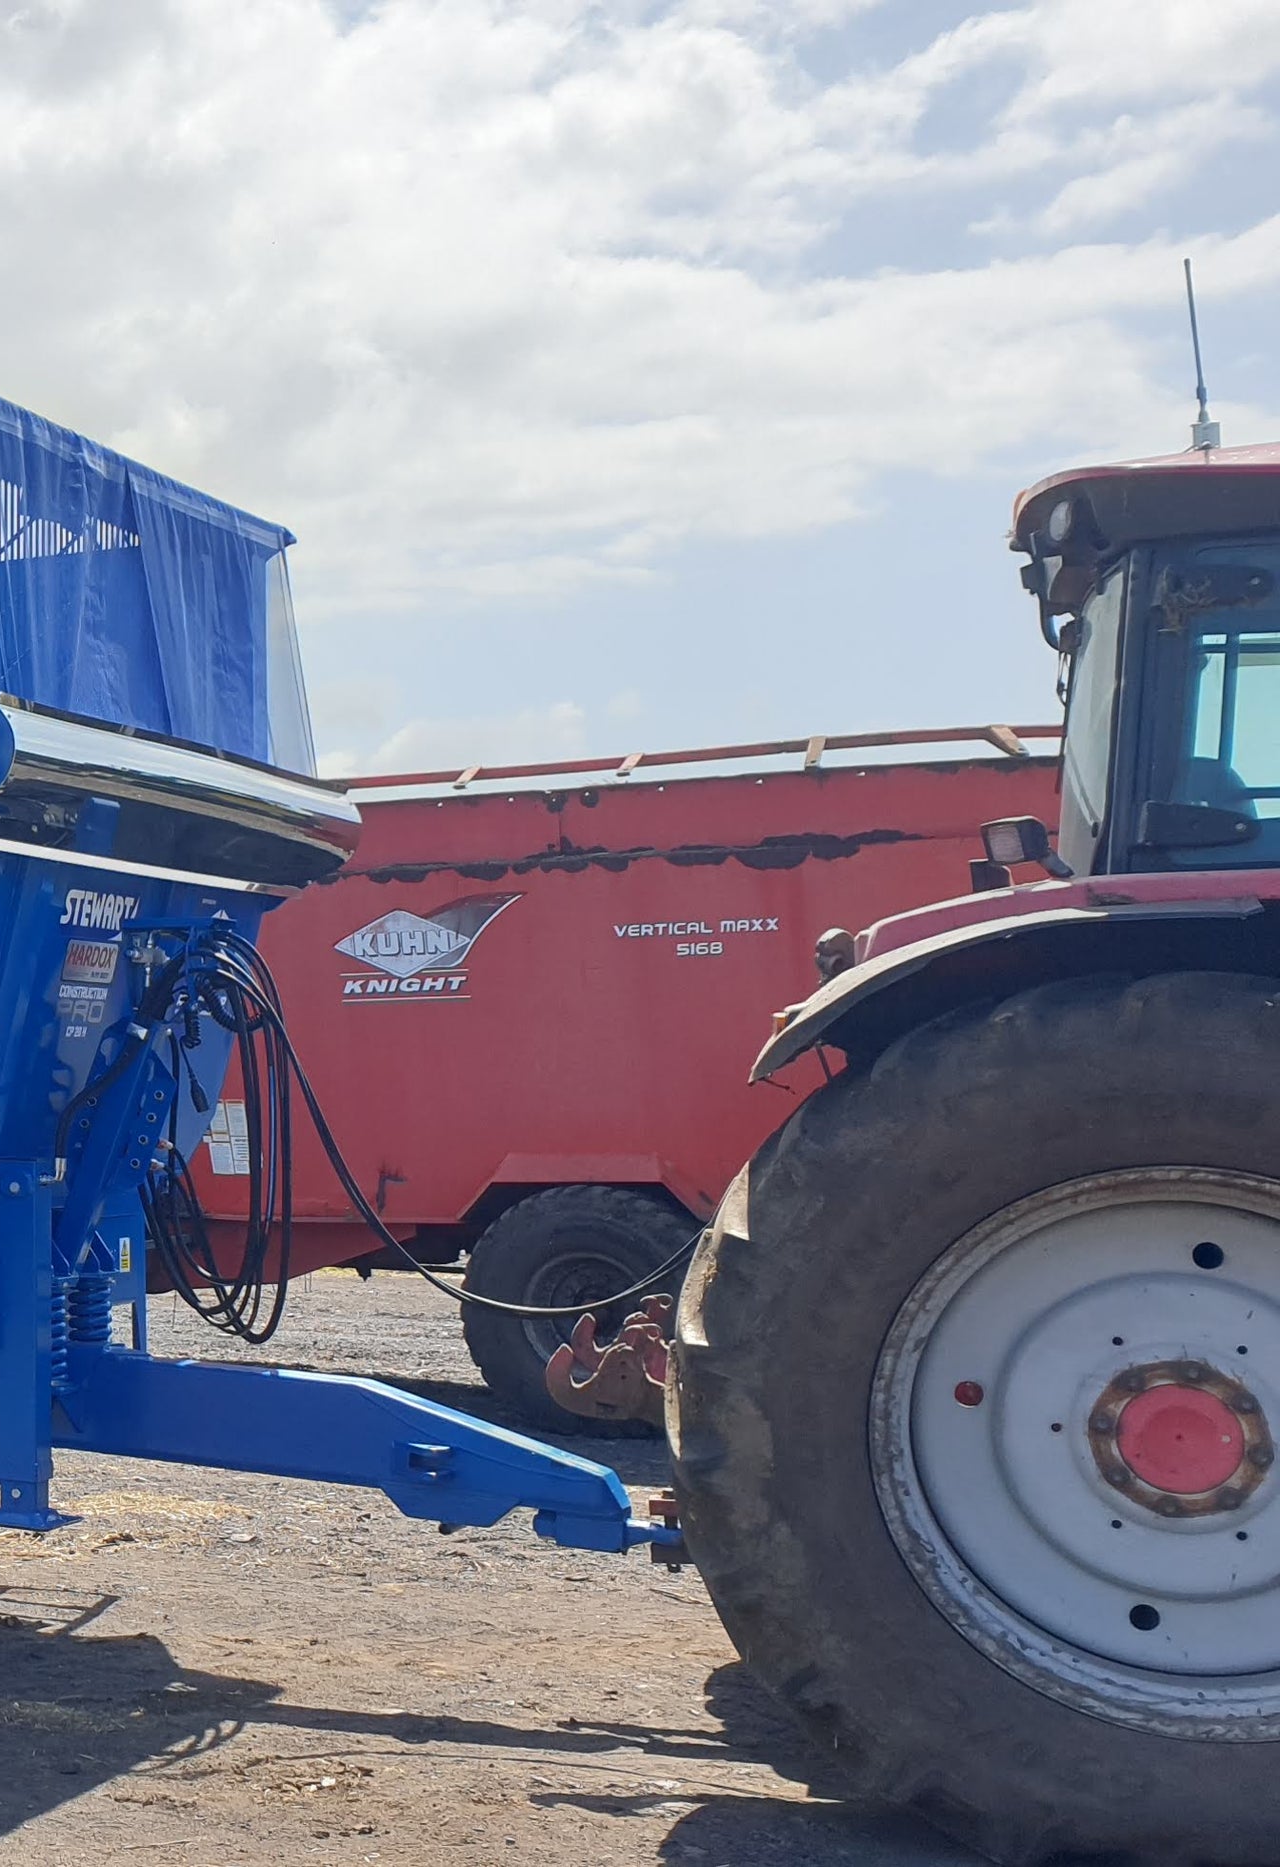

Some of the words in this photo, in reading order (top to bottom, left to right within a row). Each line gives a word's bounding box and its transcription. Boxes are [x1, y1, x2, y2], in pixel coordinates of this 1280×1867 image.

[614, 921, 714, 938] VERTICAL
[720, 917, 779, 934] MAXX
[353, 929, 450, 957] KUHN
[676, 941, 724, 957] 5168
[67, 943, 115, 969] HARDOX
[343, 974, 467, 995] KNIGHT
[57, 1000, 105, 1024] PRO
